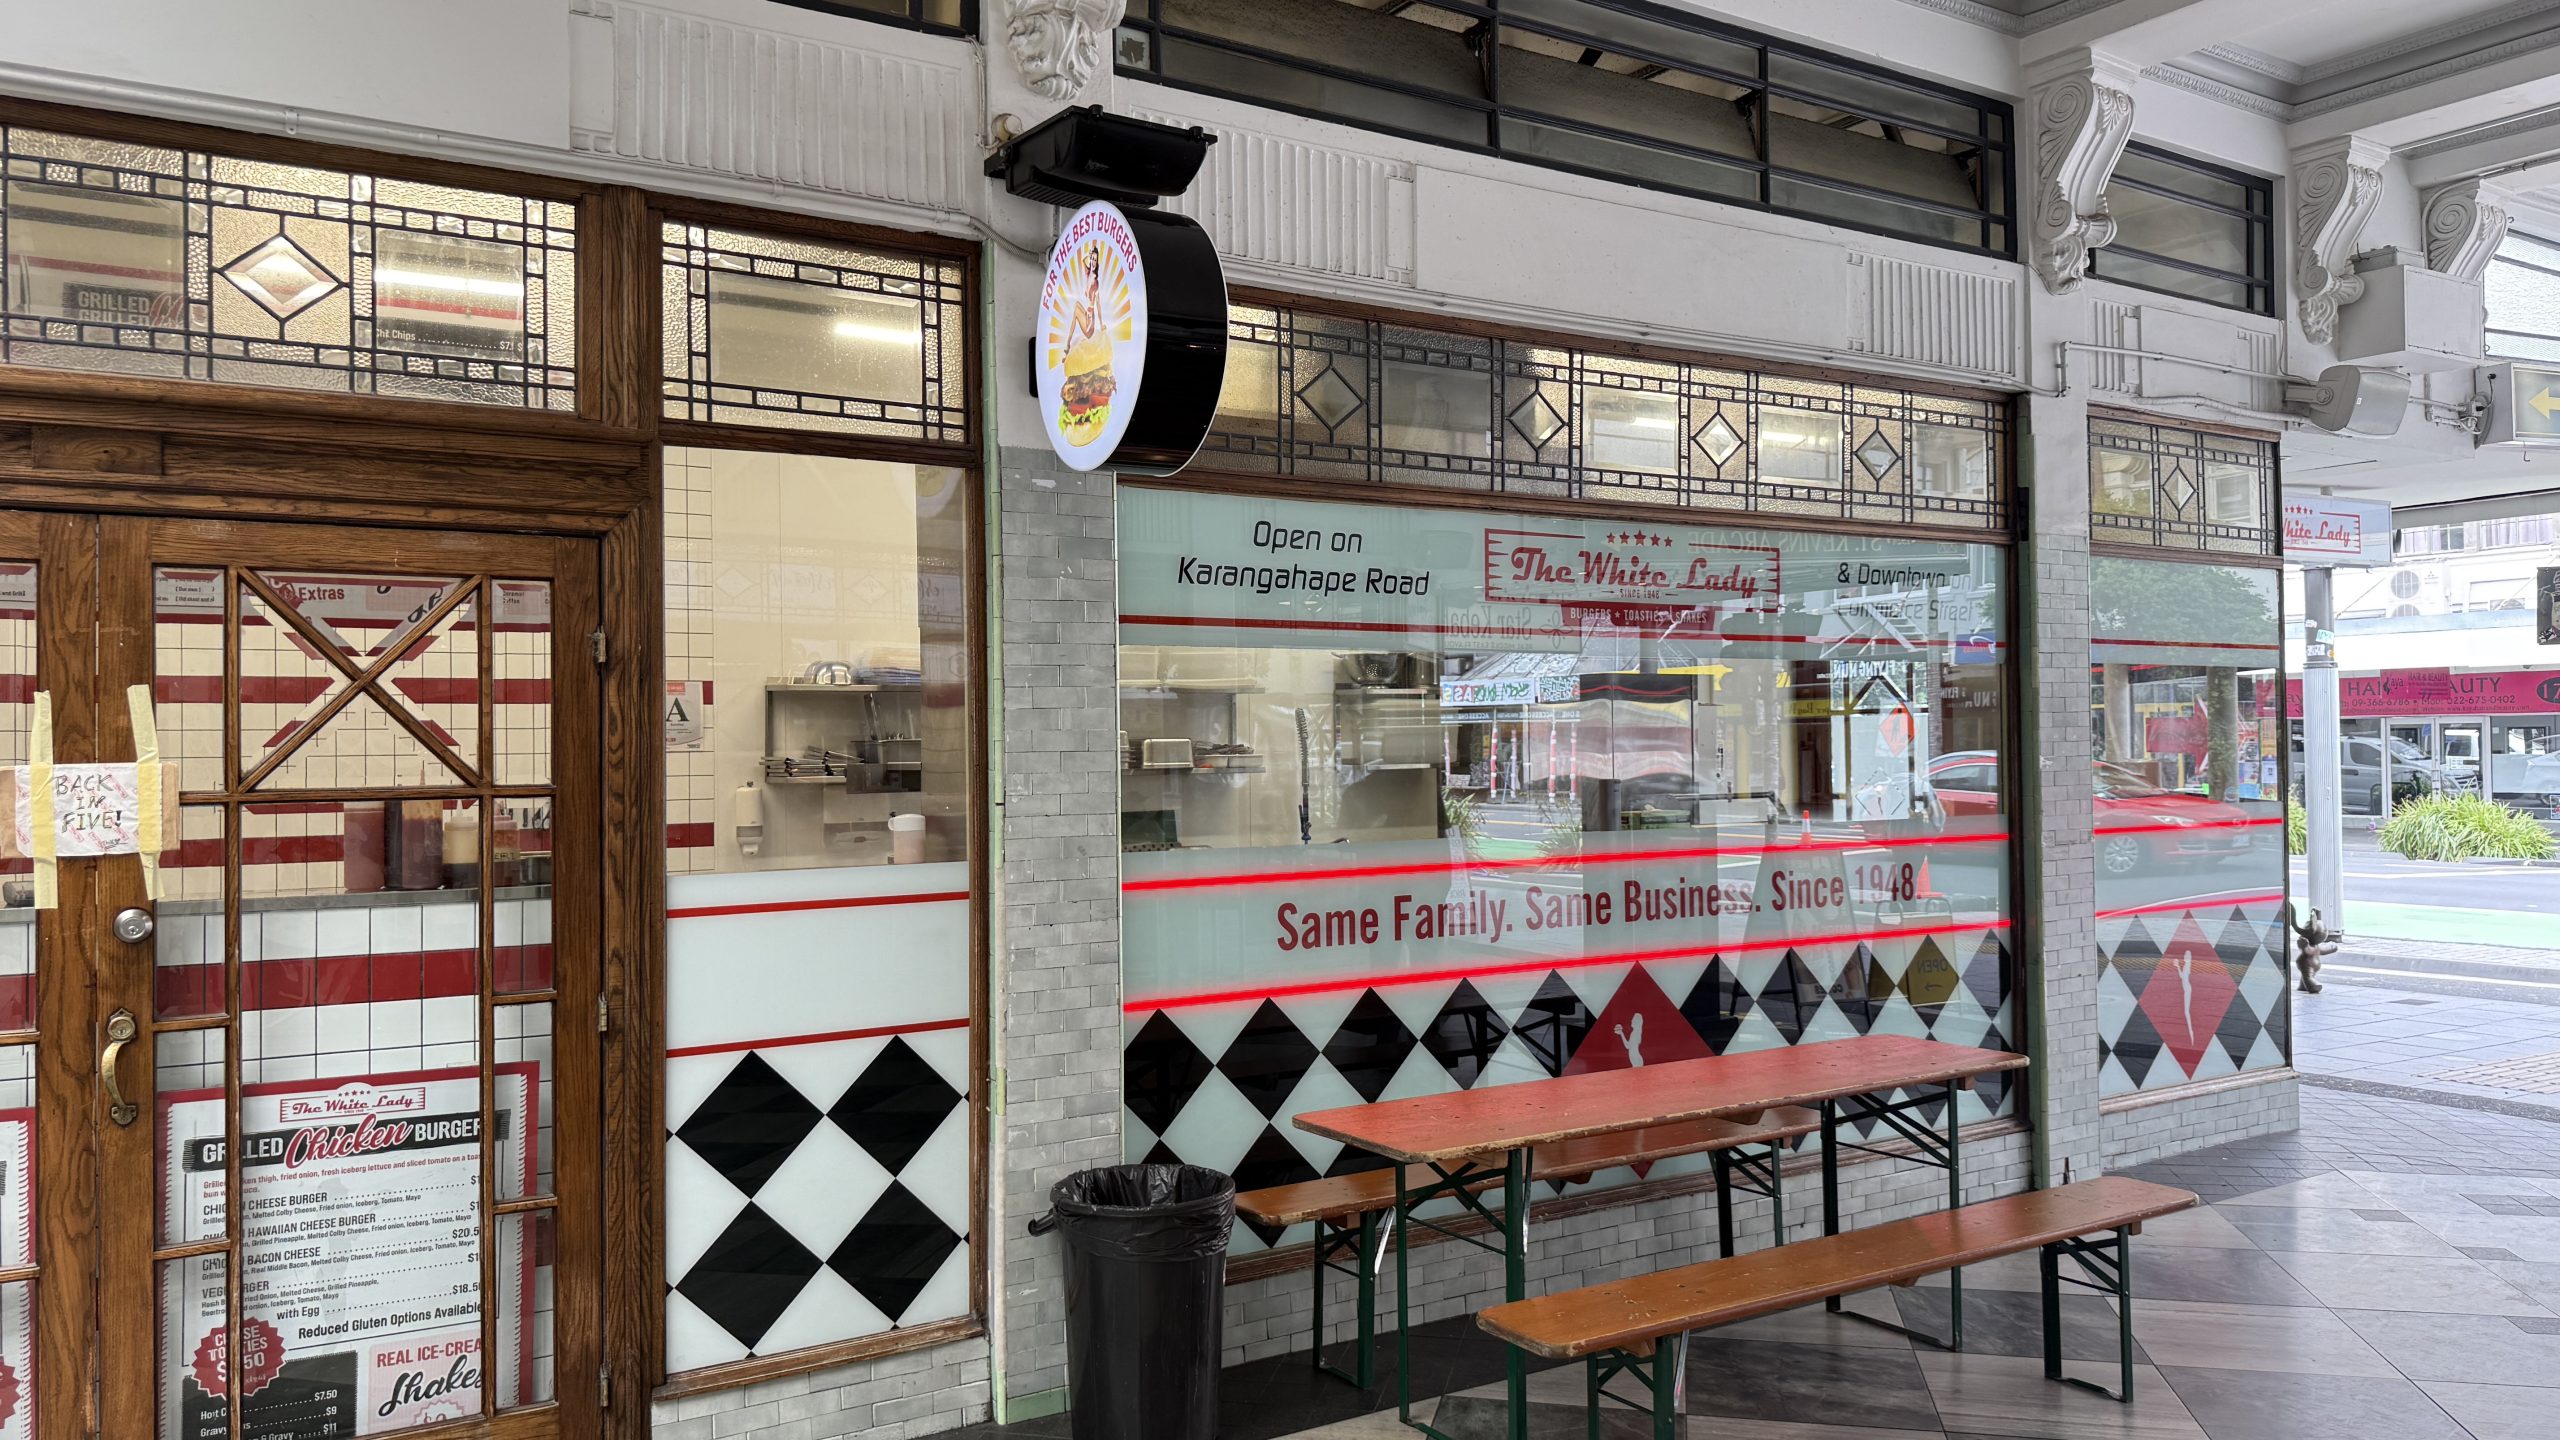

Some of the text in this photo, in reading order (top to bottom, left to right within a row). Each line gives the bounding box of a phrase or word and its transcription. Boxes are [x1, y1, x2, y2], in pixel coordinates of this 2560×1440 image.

[1042, 211, 1138, 311] FOR THE BEST BURGERS
[78, 290, 150, 314] GRILLED
[1252, 520, 1363, 554] Open on
[2314, 519, 2352, 548] Lady
[1177, 556, 1430, 597] Karangahape Road
[1511, 546, 1764, 599] The White Lady
[1837, 562, 1972, 591] & Downtown on
[298, 586, 345, 601] Extras
[1619, 588, 1642, 599] SINCE
[1570, 607, 1612, 621] BURGERS
[1623, 608, 1664, 623] TOASTIES
[2347, 680, 2381, 697] HAI
[665, 697, 690, 722] A
[55, 774, 114, 797] BACK
[76, 795, 106, 811] IN
[61, 810, 122, 834] FIVE!
[1276, 902, 1379, 951] Same
[1393, 889, 1513, 943] Family.
[1525, 885, 1612, 931] Same
[1623, 876, 1761, 923] Business.
[1771, 869, 1844, 911] Since
[292, 1094, 414, 1116] The White Lady
[202, 1136, 284, 1164] GRLED
[285, 1114, 414, 1169] Chicken
[258, 1174, 279, 1185] thigh,
[280, 1171, 298, 1181] fried
[298, 1170, 320, 1180] onion,
[321, 1168, 340, 1178] fresh
[340, 1165, 367, 1176] iceberg
[367, 1161, 392, 1171] lettuce
[392, 1160, 406, 1169] and
[407, 1157, 427, 1167] sliced
[427, 1156, 451, 1165] tomato
[203, 1199, 246, 1216] CHICN
[248, 1196, 287, 1211] CHEESE
[289, 1192, 328, 1206] BURGER
[252, 1210, 275, 1219] Melted
[276, 1208, 294, 1217] Colby
[319, 1203, 336, 1212] Fried
[335, 1201, 355, 1210] onion,
[355, 1198, 380, 1208] Iceberg,
[381, 1195, 405, 1205] Tomato,
[405, 1194, 422, 1203] Mayo
[247, 1222, 298, 1239] HAWAIIAN
[299, 1218, 337, 1232] CHEESE
[338, 1213, 376, 1228] BURGER
[251, 1238, 274, 1248] Grilled
[307, 1231, 329, 1240] Melted
[329, 1228, 346, 1238] Colby
[371, 1223, 387, 1232] Fried
[406, 1218, 431, 1228] Iceberg,
[431, 1215, 455, 1225] Tomato,
[455, 1213, 472, 1223] Mayo
[247, 1251, 281, 1266] BACON
[283, 1246, 321, 1261] CHEESE
[452, 1226, 480, 1240] $20.5
[251, 1265, 267, 1275] Real
[267, 1262, 288, 1272] Middle
[289, 1260, 310, 1270] Bacon,
[310, 1257, 332, 1267] Melted
[332, 1255, 349, 1265] Colby
[374, 1249, 390, 1259] Fried
[409, 1244, 434, 1254] Iceberg,
[434, 1241, 458, 1251] Tomato,
[458, 1239, 475, 1249] Mayo
[259, 1293, 280, 1302] Onion,
[280, 1289, 302, 1299] Melted
[327, 1281, 348, 1293] Grilled
[297, 1294, 322, 1304] Tomato,
[322, 1292, 340, 1302] Mayo
[276, 1307, 299, 1320] with
[301, 1305, 320, 1317] Egg
[298, 1320, 349, 1339] Reduced
[352, 1317, 388, 1331] Gluten
[390, 1310, 432, 1327] Options
[377, 1338, 481, 1368] REAL ICE-CREA
[314, 1389, 338, 1401] $7.50
[325, 1405, 337, 1416] $9
[323, 1423, 337, 1434] $11
